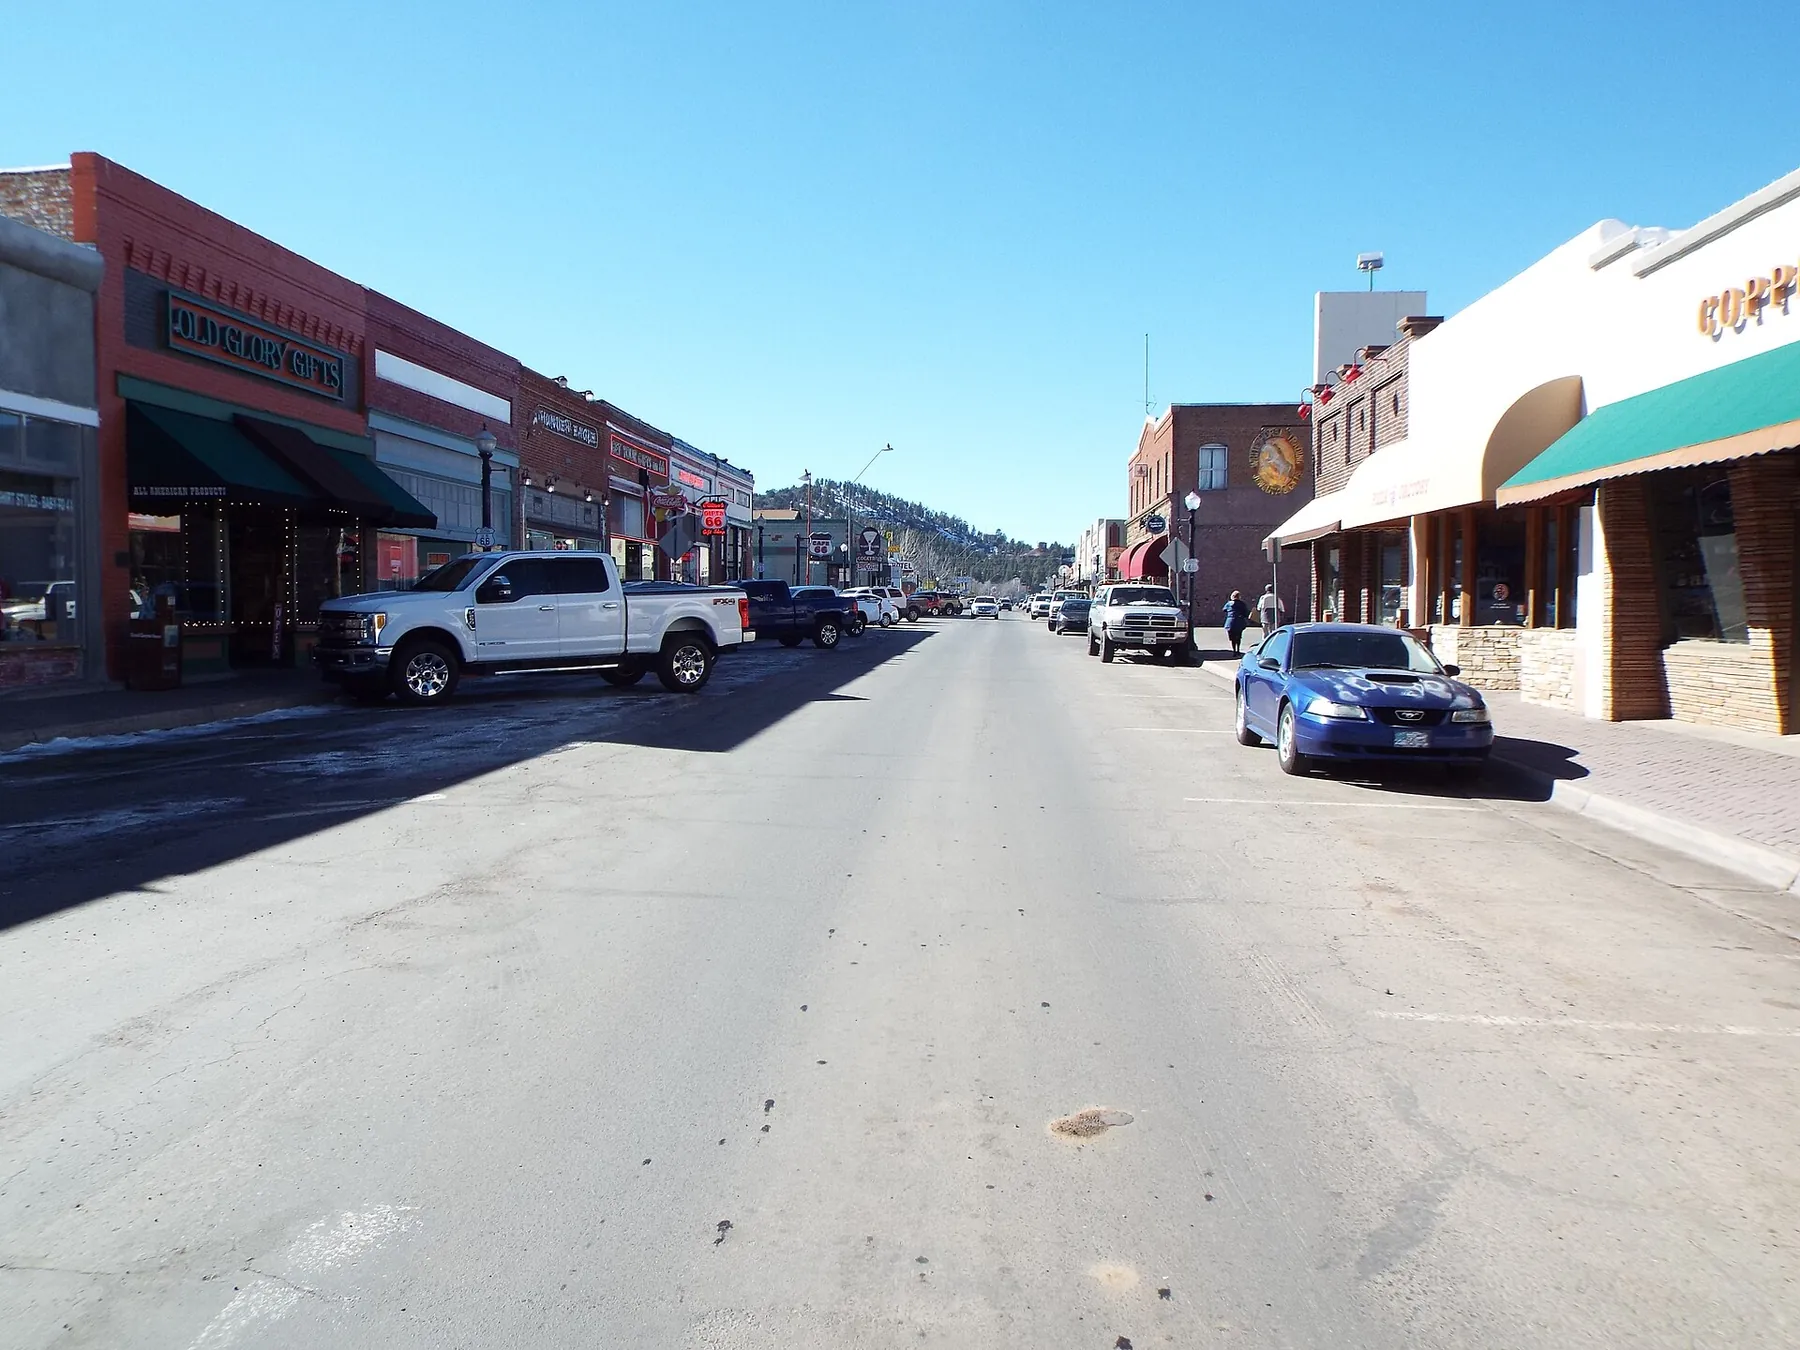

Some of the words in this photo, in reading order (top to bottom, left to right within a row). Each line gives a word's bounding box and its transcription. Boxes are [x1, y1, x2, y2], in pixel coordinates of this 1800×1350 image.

[1699, 257, 1800, 335] COPP
[178, 309, 220, 347] OLD
[225, 326, 290, 373] GLORY
[292, 350, 340, 388] GIFTS
[134, 487, 148, 496] ALL
[149, 487, 188, 496] AMERICAN
[705, 516, 722, 527] 66
[480, 537, 490, 545] 66
[713, 598, 736, 606] FX4
